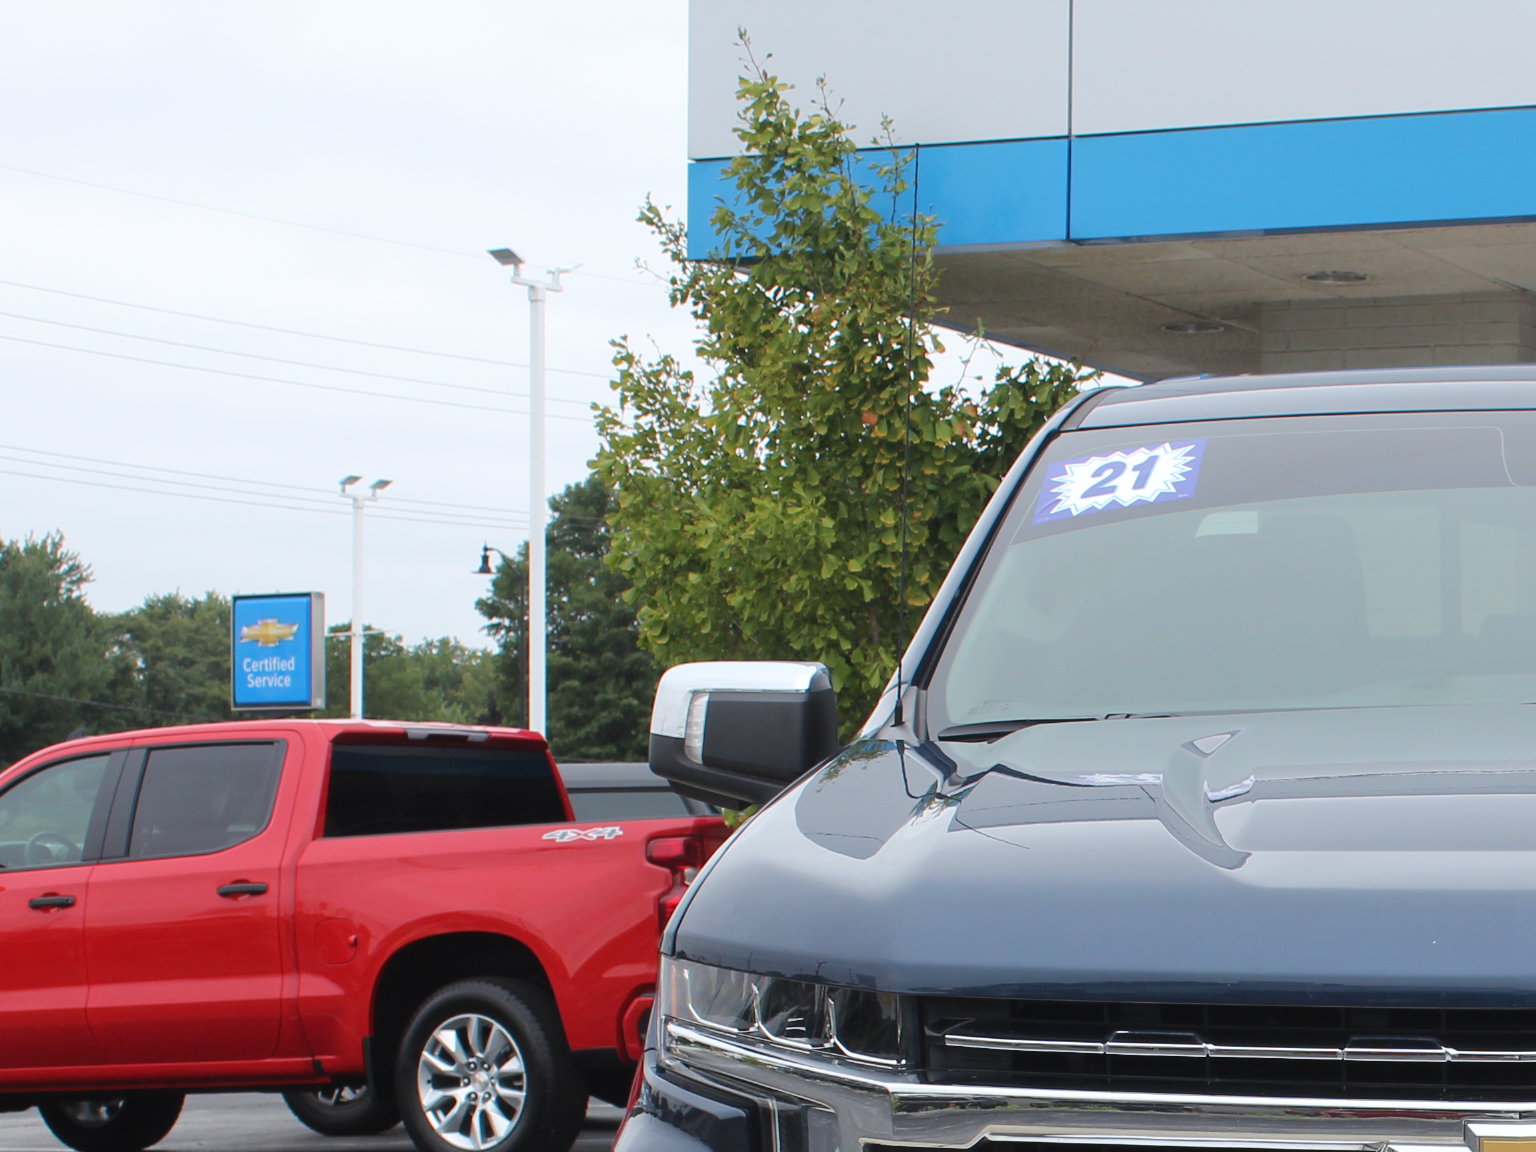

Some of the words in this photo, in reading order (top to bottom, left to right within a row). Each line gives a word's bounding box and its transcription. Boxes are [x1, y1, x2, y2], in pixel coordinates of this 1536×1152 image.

[1081, 455, 1160, 499] 21
[243, 657, 295, 672] Certified
[246, 674, 291, 688] Service
